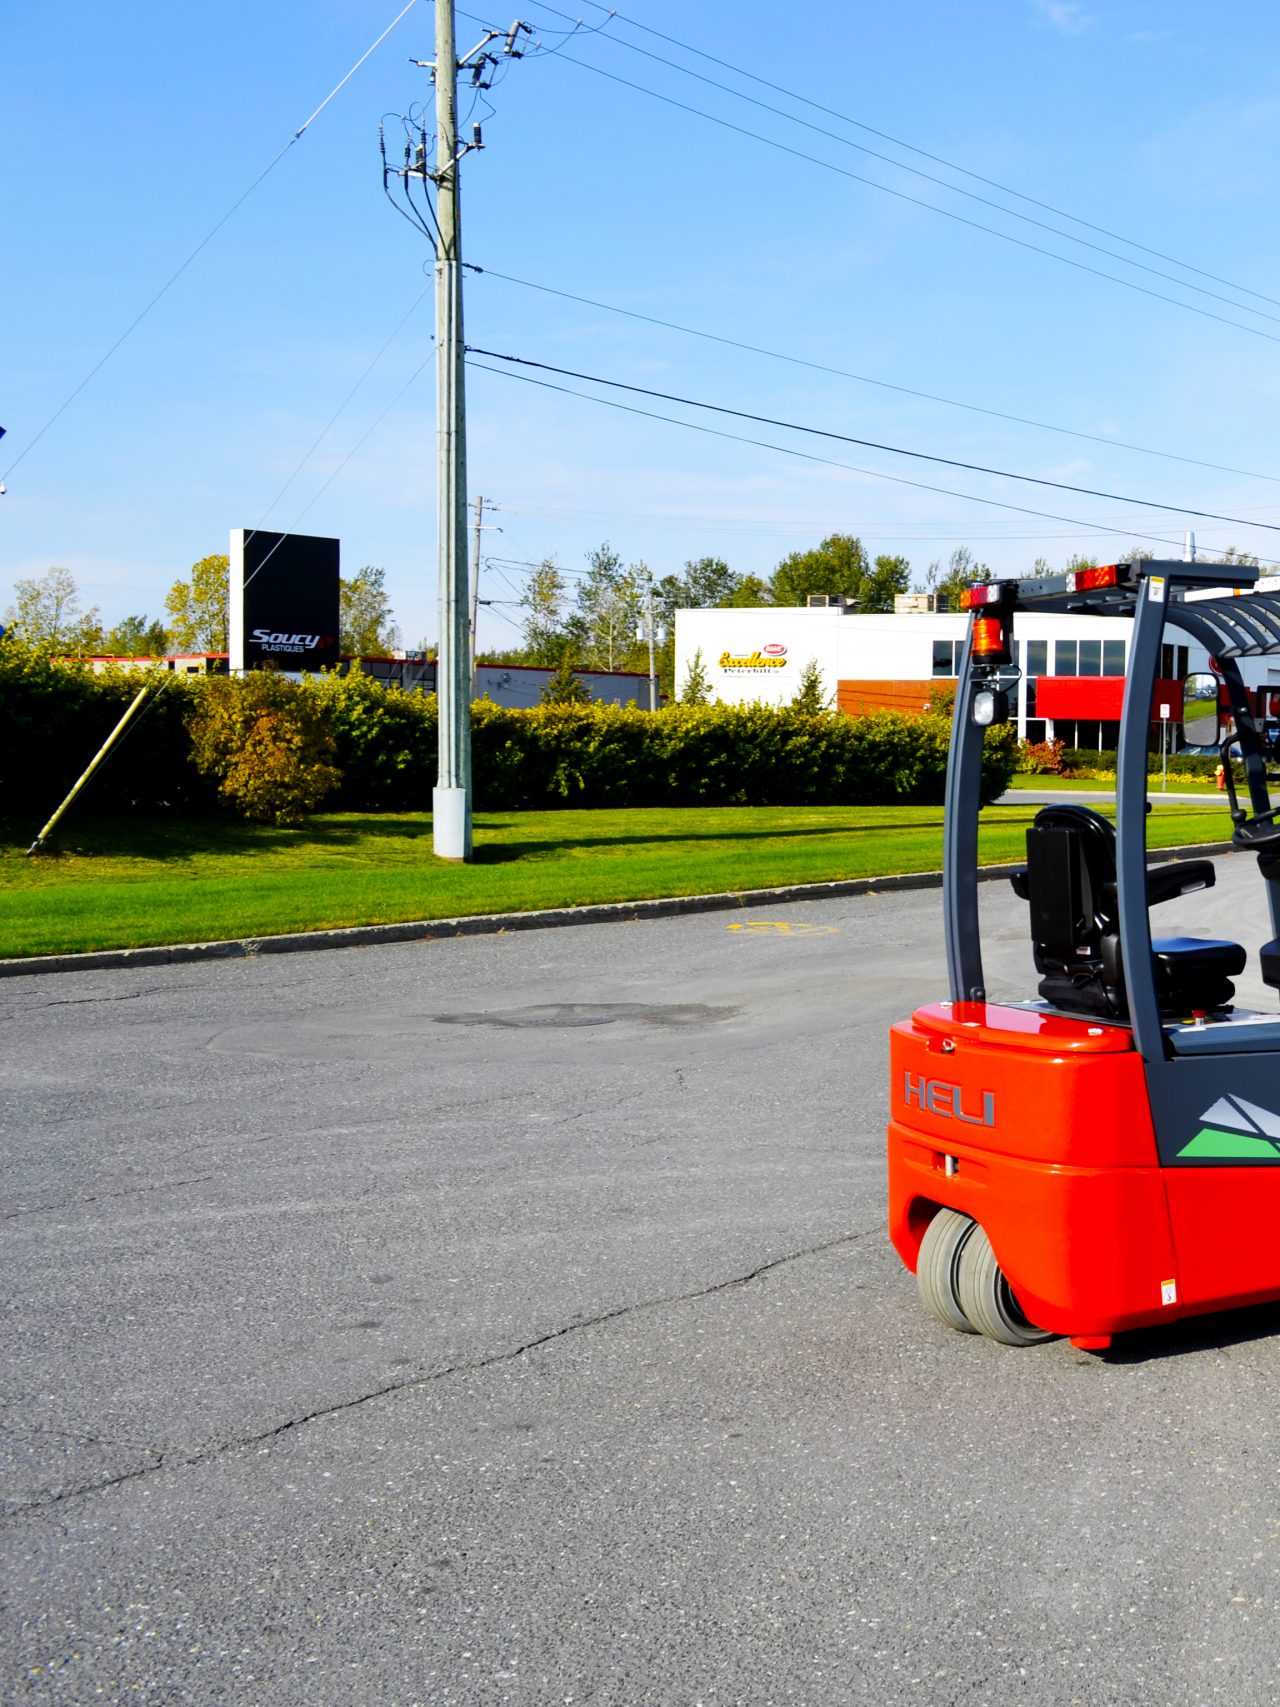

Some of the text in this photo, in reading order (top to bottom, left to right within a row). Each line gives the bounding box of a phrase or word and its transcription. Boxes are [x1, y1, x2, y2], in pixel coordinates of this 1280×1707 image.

[261, 643, 305, 653] PLASTIQUES
[718, 651, 787, 668] Excellence
[904, 1072, 995, 1128] HELI
